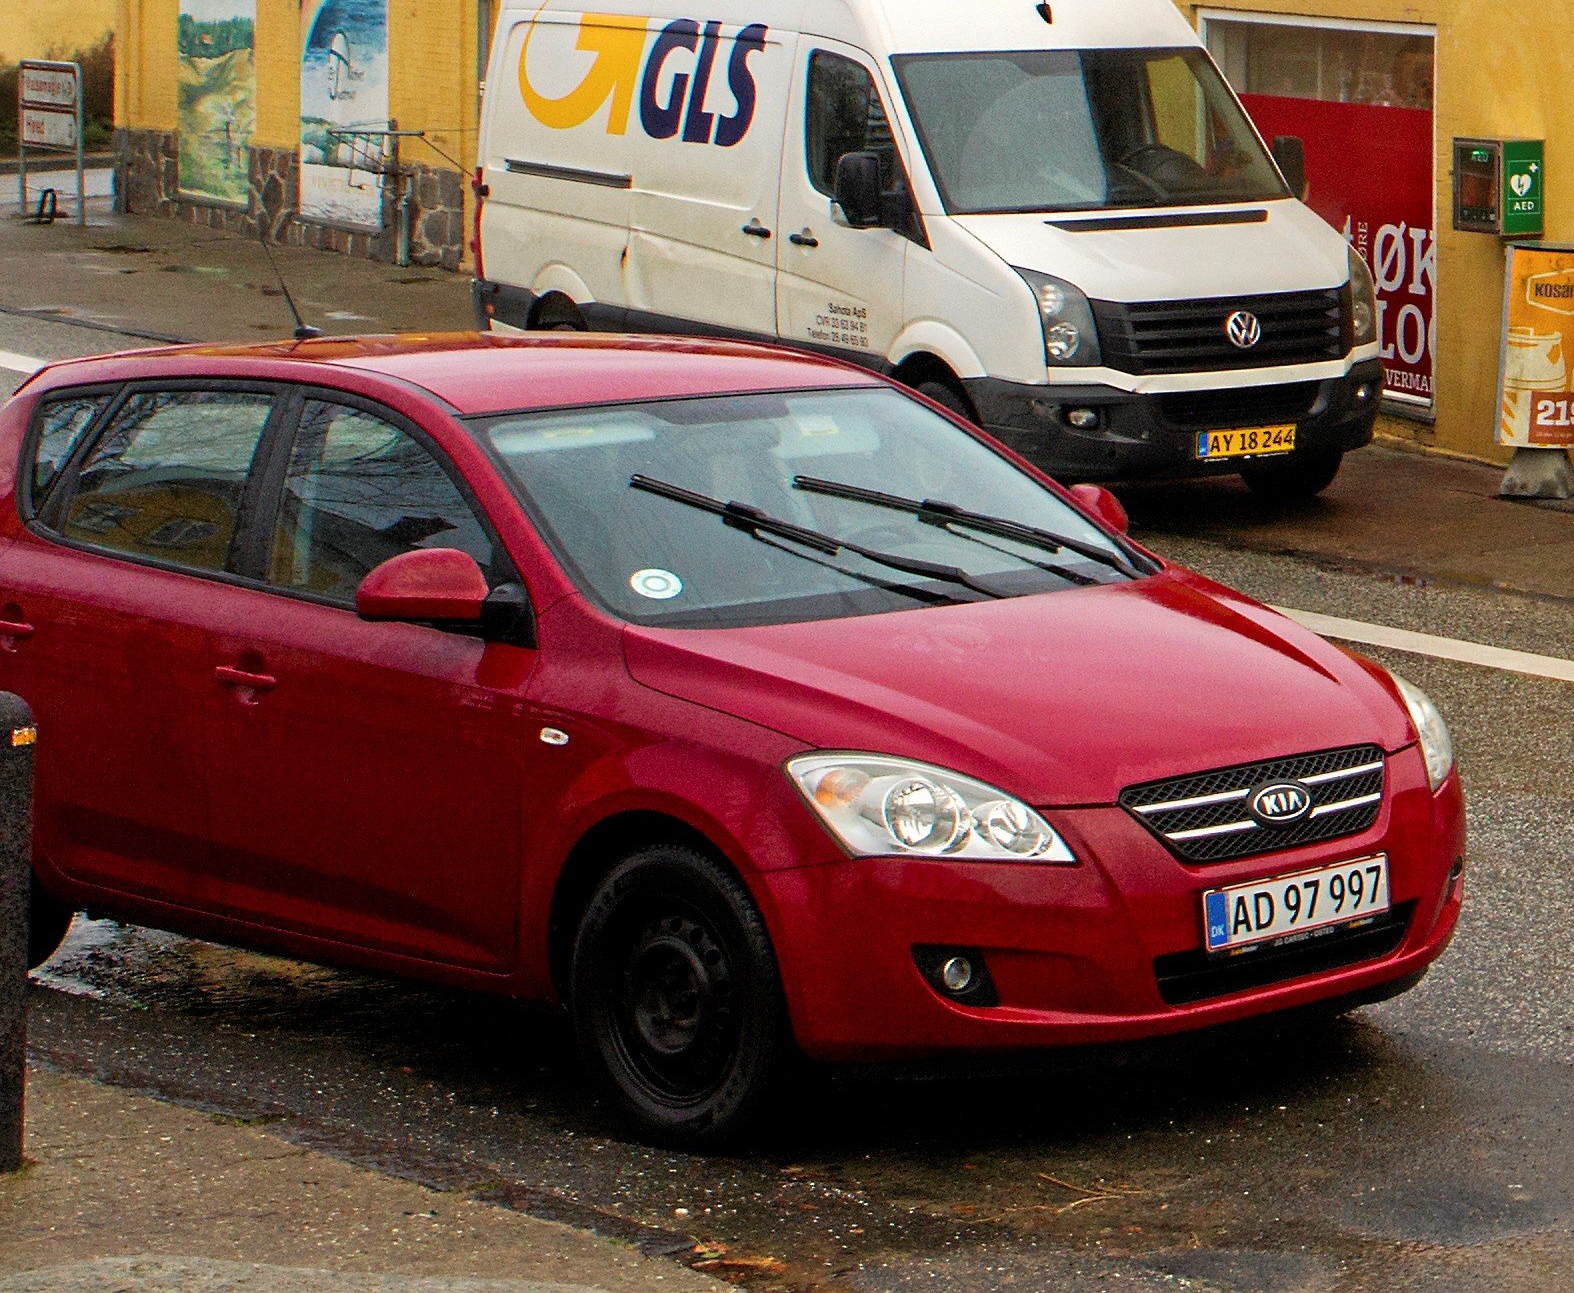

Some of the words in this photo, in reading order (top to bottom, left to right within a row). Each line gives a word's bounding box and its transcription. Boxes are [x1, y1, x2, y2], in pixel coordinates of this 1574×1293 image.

[640, 18, 768, 147] GLS
[1513, 201, 1535, 211] AED
[1384, 369, 1433, 393] VERMA
[1210, 433, 1233, 452] AY
[1240, 431, 1258, 451] 18
[1262, 429, 1294, 448] 244
[1261, 791, 1304, 815] KIA
[1232, 891, 1275, 935] AD
[1283, 879, 1320, 924] 97
[1329, 864, 1382, 914] 997
[1211, 926, 1225, 938] DK
